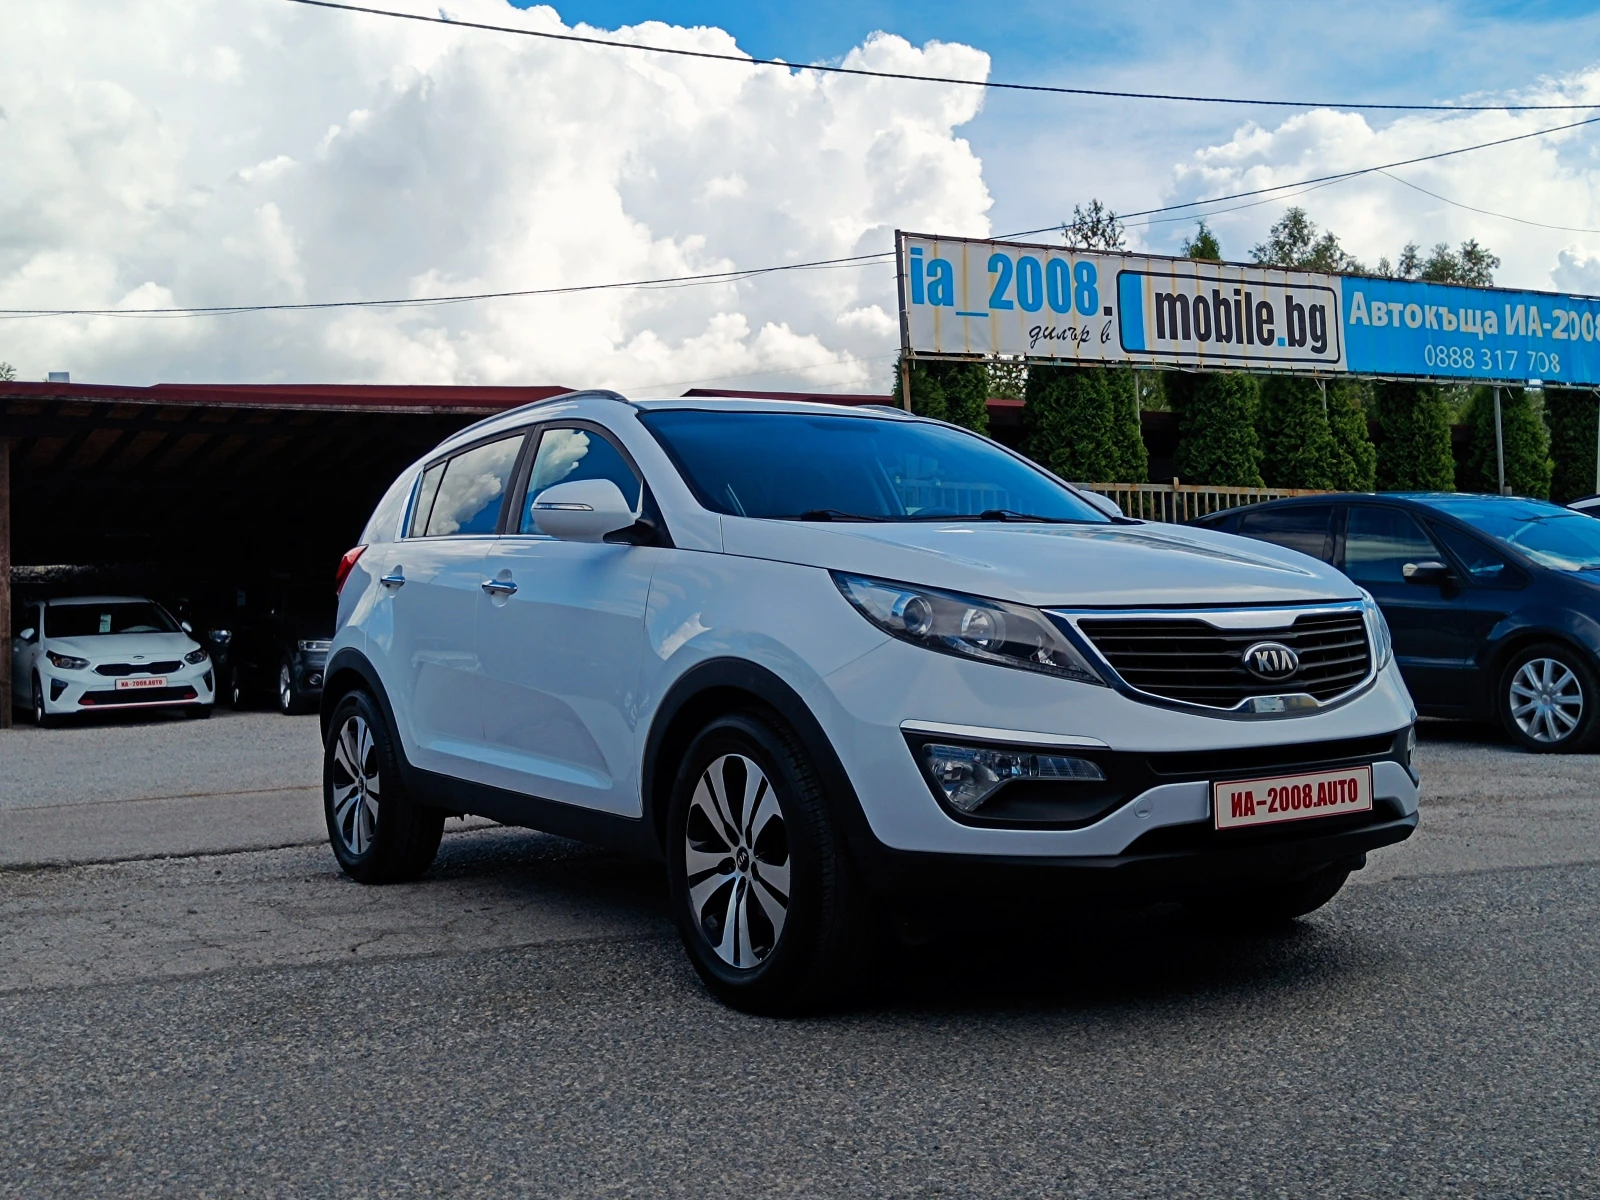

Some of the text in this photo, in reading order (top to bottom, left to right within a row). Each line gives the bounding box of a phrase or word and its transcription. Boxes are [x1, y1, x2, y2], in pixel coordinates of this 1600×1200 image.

[1155, 288, 1328, 354] mobile.bg
[1349, 291, 1498, 341] Автокъща
[1424, 344, 1560, 373] 0888 317 708
[1254, 650, 1294, 672] KIA
